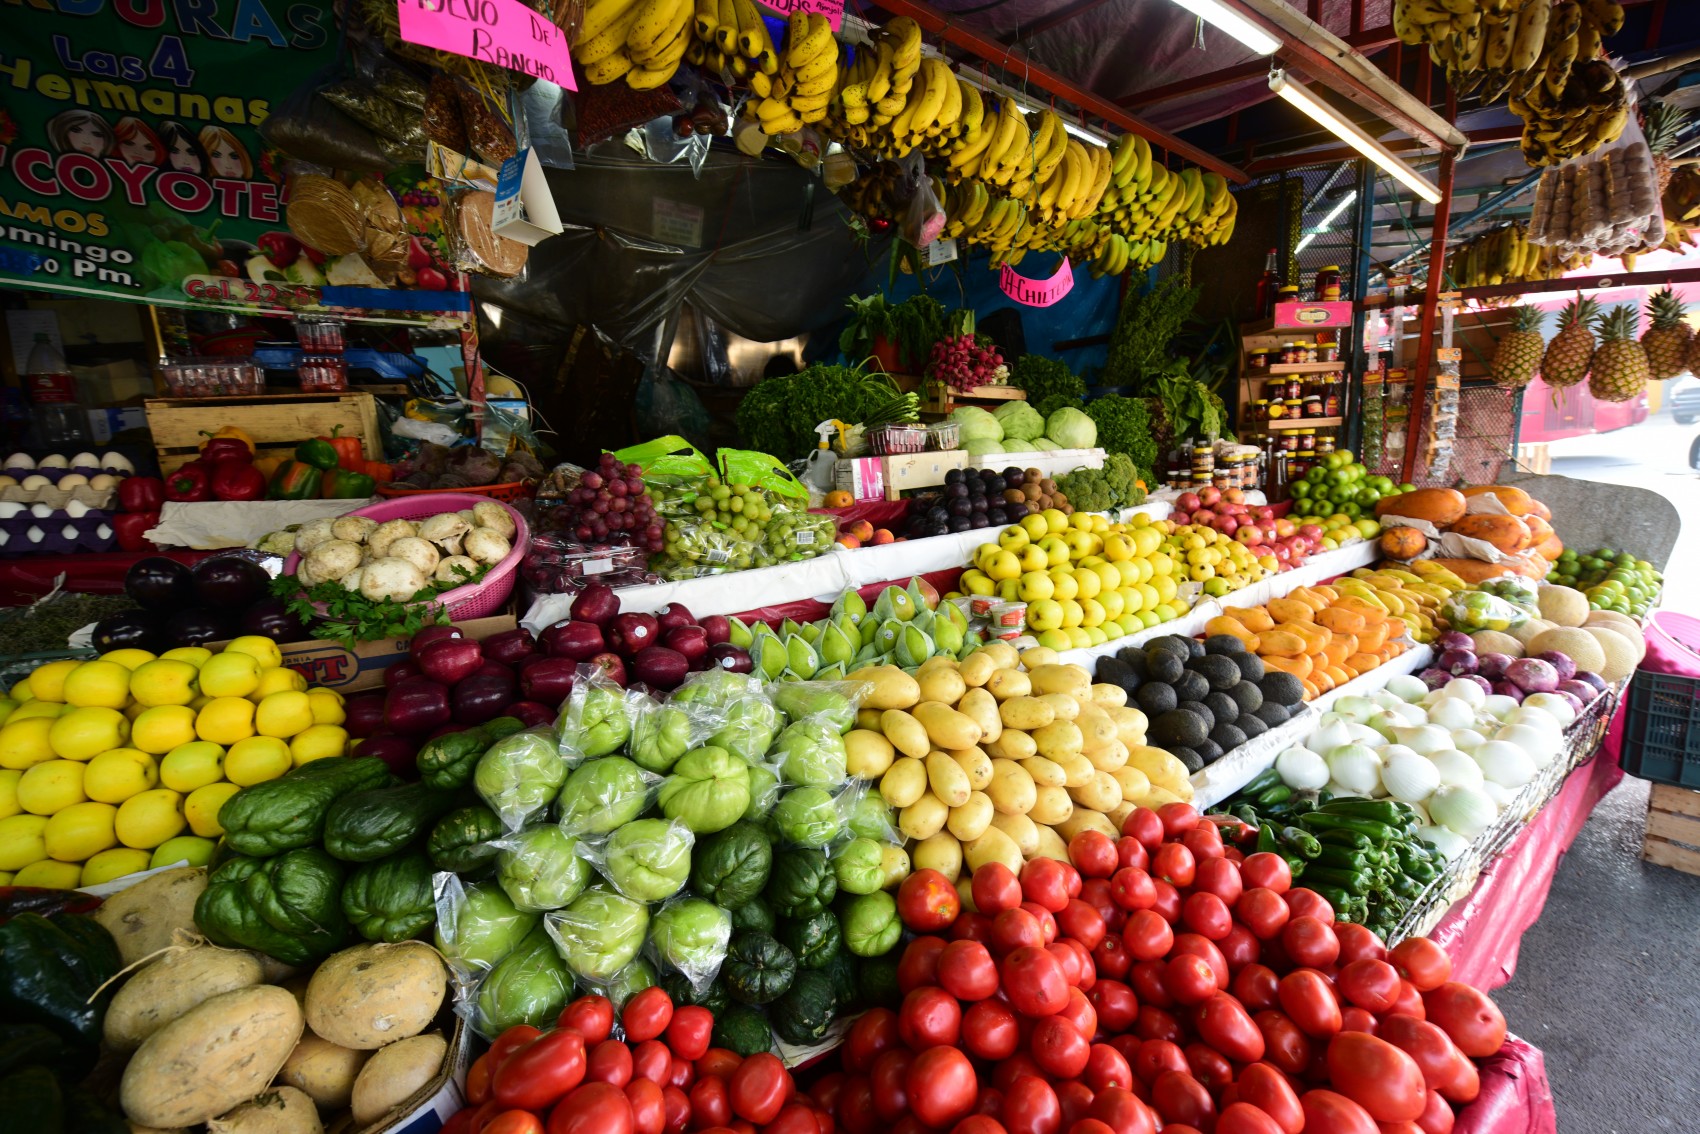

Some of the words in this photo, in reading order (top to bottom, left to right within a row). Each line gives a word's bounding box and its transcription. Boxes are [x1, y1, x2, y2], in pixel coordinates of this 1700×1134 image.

[529, 13, 552, 47] DE
[52, 34, 147, 83] Las
[148, 34, 196, 88] 4
[0, 55, 271, 127] Hermanas
[0, 225, 133, 264] mingo
[186, 279, 237, 301] Cel.
